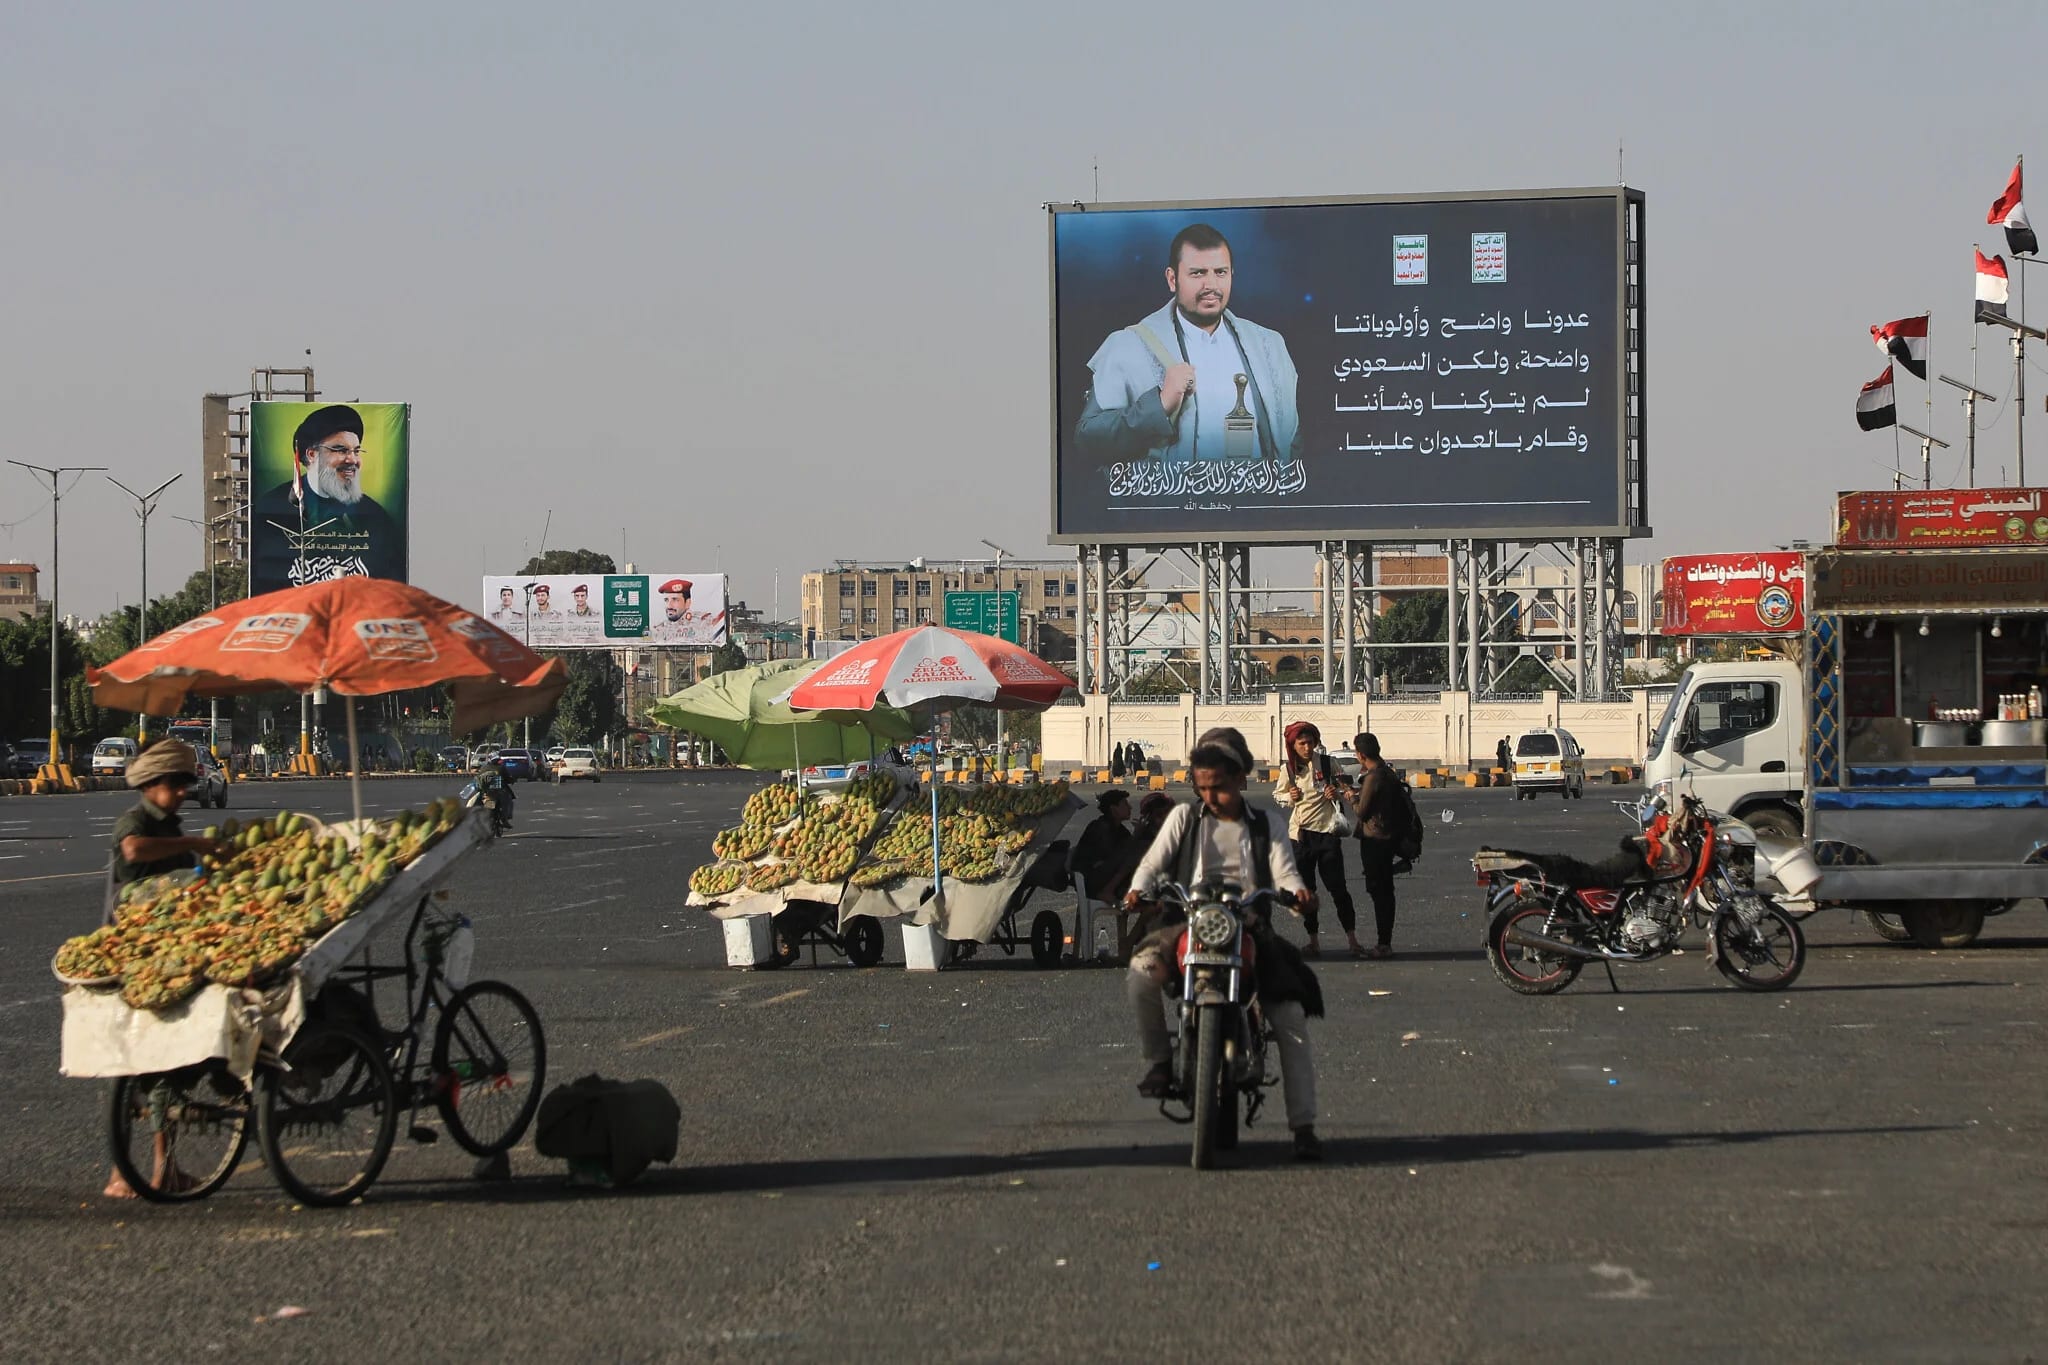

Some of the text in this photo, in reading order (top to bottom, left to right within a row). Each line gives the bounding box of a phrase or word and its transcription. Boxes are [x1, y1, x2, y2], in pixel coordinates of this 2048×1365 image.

[1334, 305, 1590, 338] عدونا واضح وأولوياتنا
[1333, 348, 1590, 382] واضحة، ولكن السعودي
[1334, 385, 1590, 416] لم يتركنا وشأننا
[1338, 425, 1589, 456] وقام بالعدوان علينا.
[1959, 491, 2040, 522] الحبيشي
[1687, 560, 1776, 585] والسندوتشات
[363, 622, 417, 635] ONE
